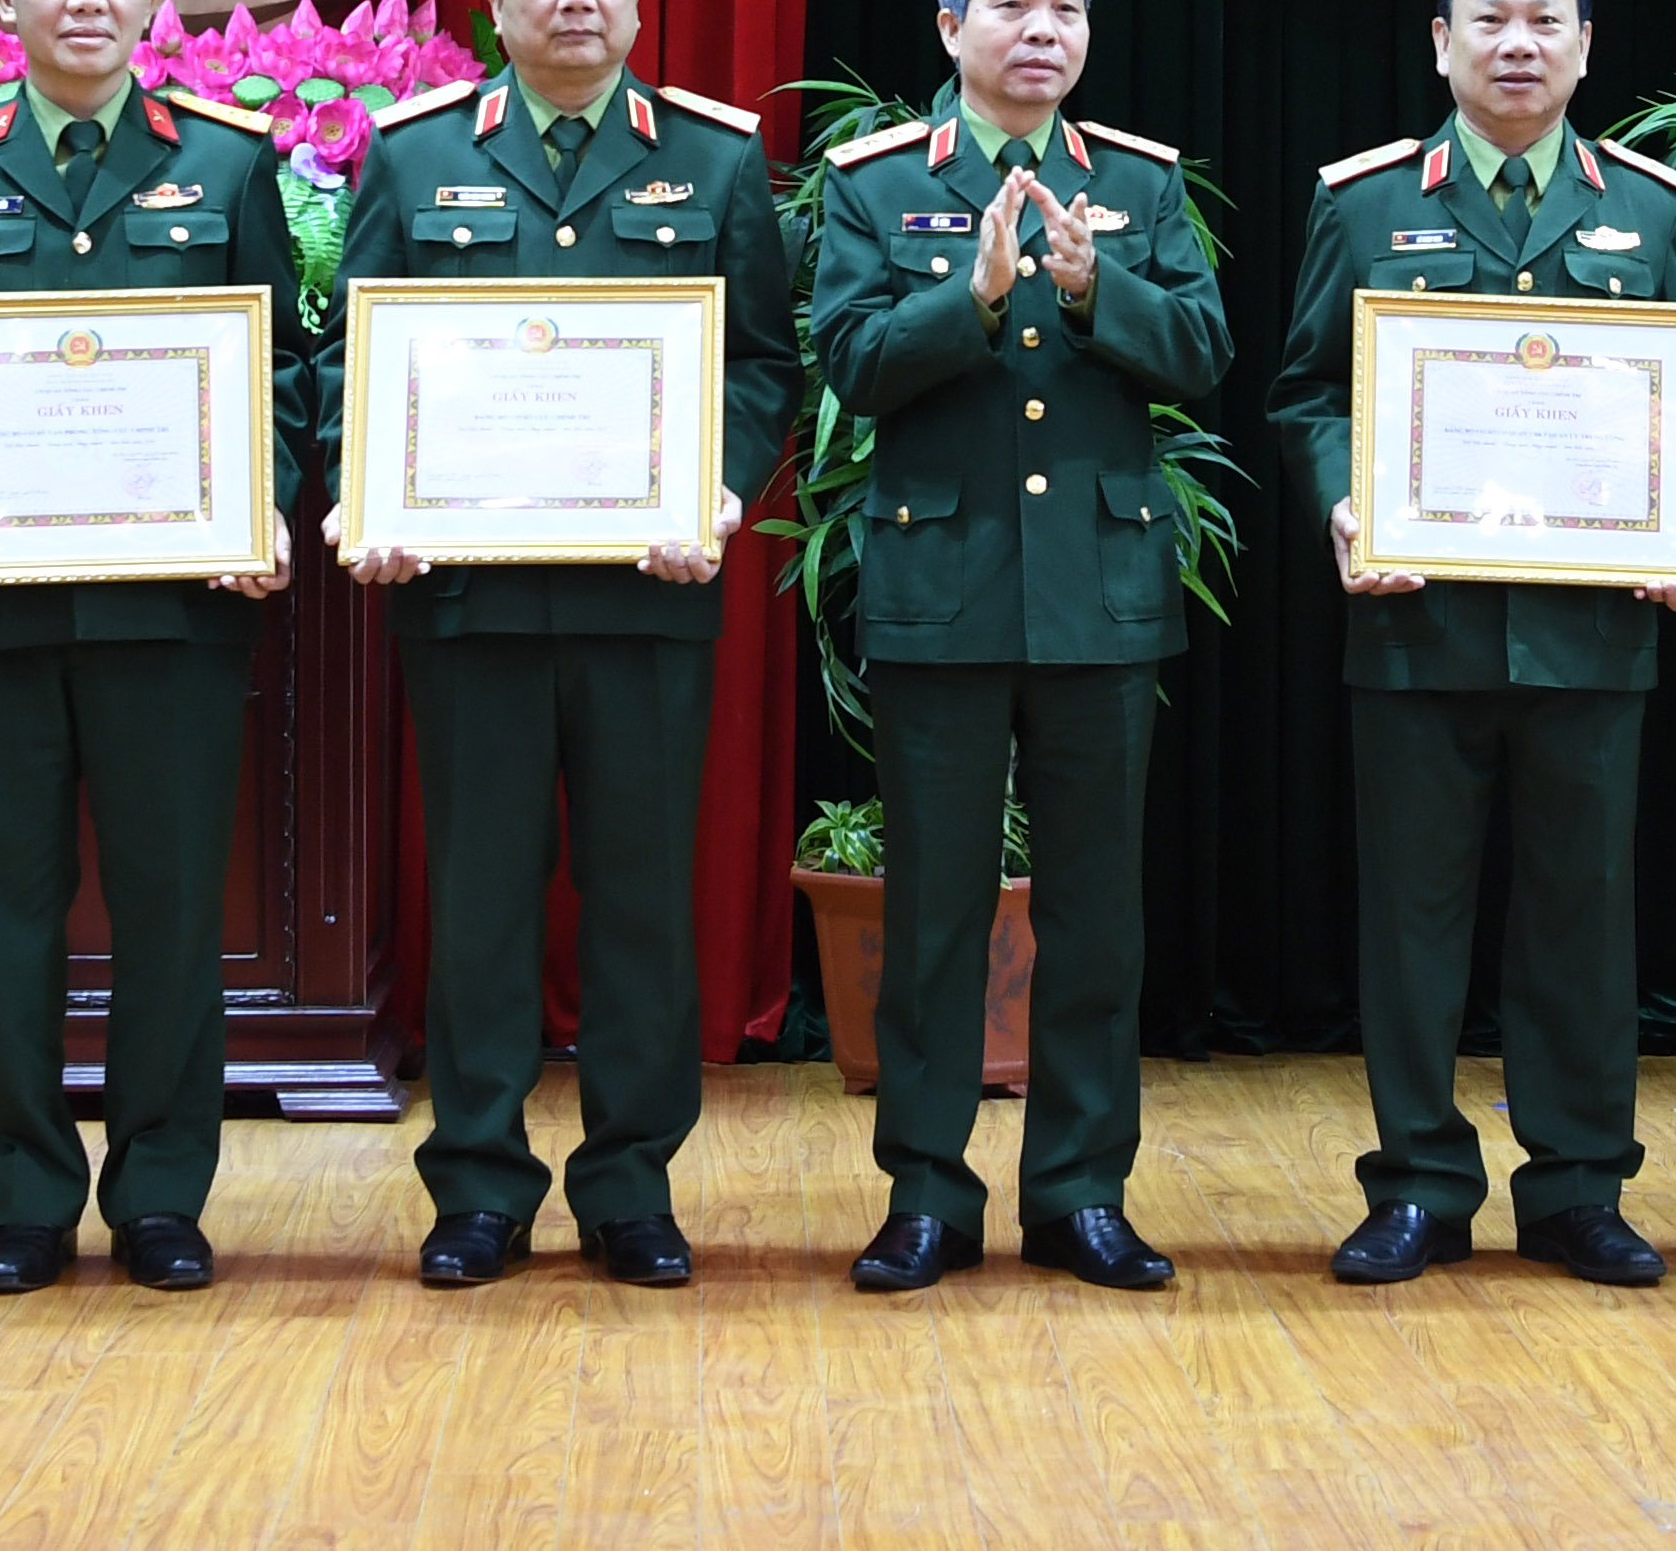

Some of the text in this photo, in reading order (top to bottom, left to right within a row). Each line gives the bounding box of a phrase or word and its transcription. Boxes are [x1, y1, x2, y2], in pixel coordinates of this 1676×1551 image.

[534, 391, 578, 403] KHEN
[79, 404, 125, 417] KHEN
[1535, 408, 1579, 422] KHEN
